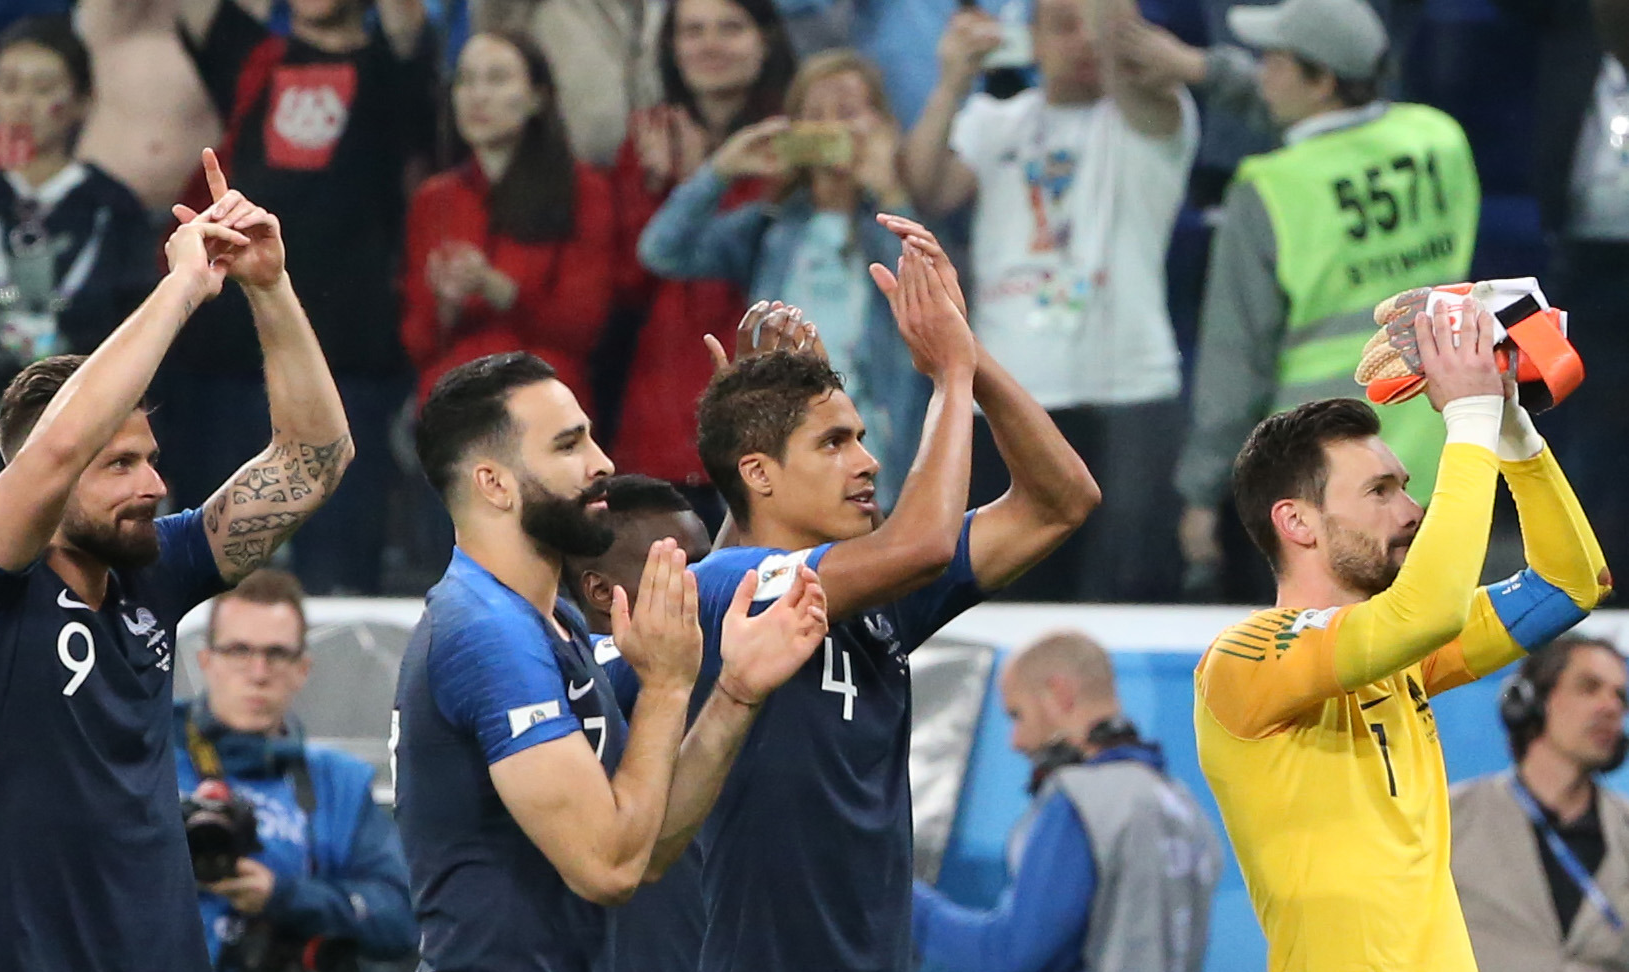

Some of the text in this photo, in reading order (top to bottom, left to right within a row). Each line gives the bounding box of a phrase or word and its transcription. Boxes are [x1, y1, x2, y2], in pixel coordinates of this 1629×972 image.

[1334, 150, 1448, 240] 5571
[57, 621, 97, 697] 9
[821, 636, 859, 721] 4
[1371, 723, 1398, 797] 1
